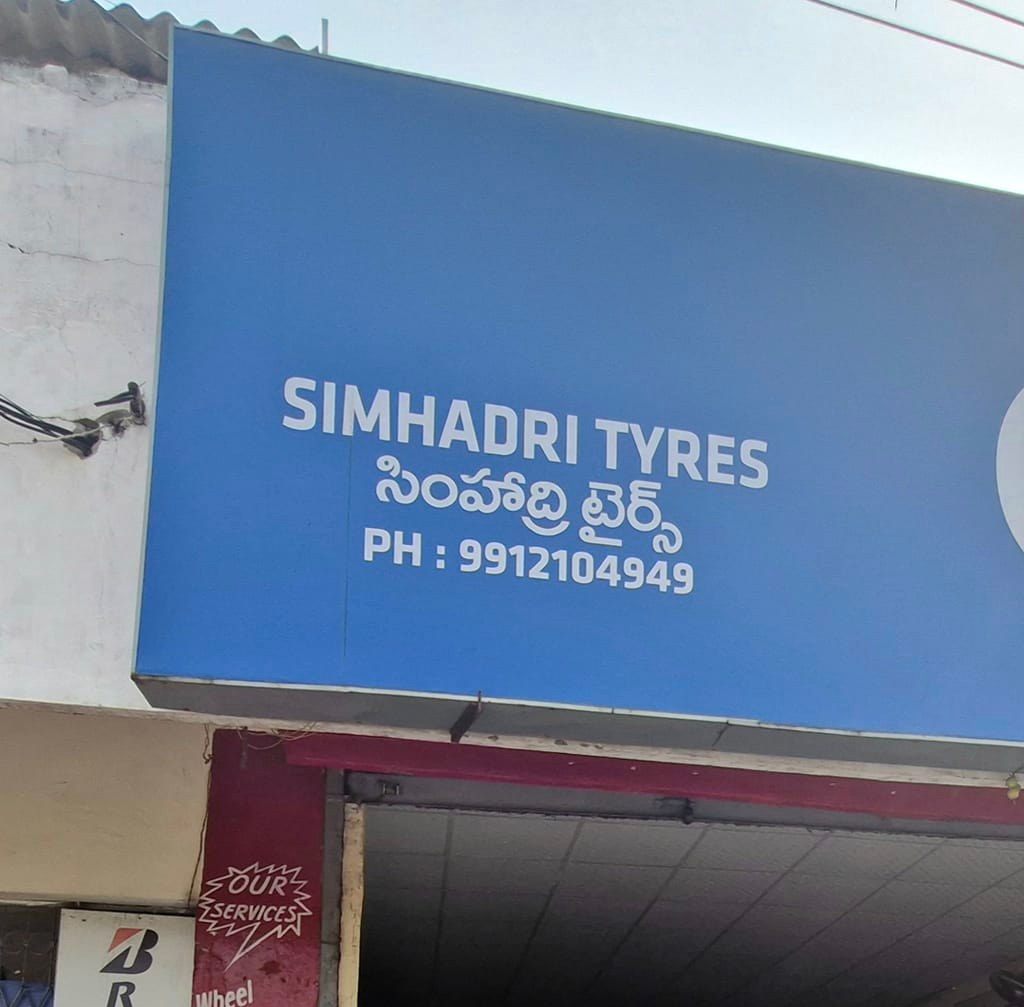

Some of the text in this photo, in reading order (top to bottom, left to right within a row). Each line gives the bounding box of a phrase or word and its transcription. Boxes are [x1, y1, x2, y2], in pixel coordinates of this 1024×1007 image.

[282, 376, 770, 490] SIMHADRI TYRES
[375, 455, 684, 555] సింహాద్రి టైర్స్
[363, 527, 423, 567] PH
[458, 538, 695, 595] 9912104949
[209, 902, 298, 923] SERVICES
[228, 874, 288, 896] OUR
